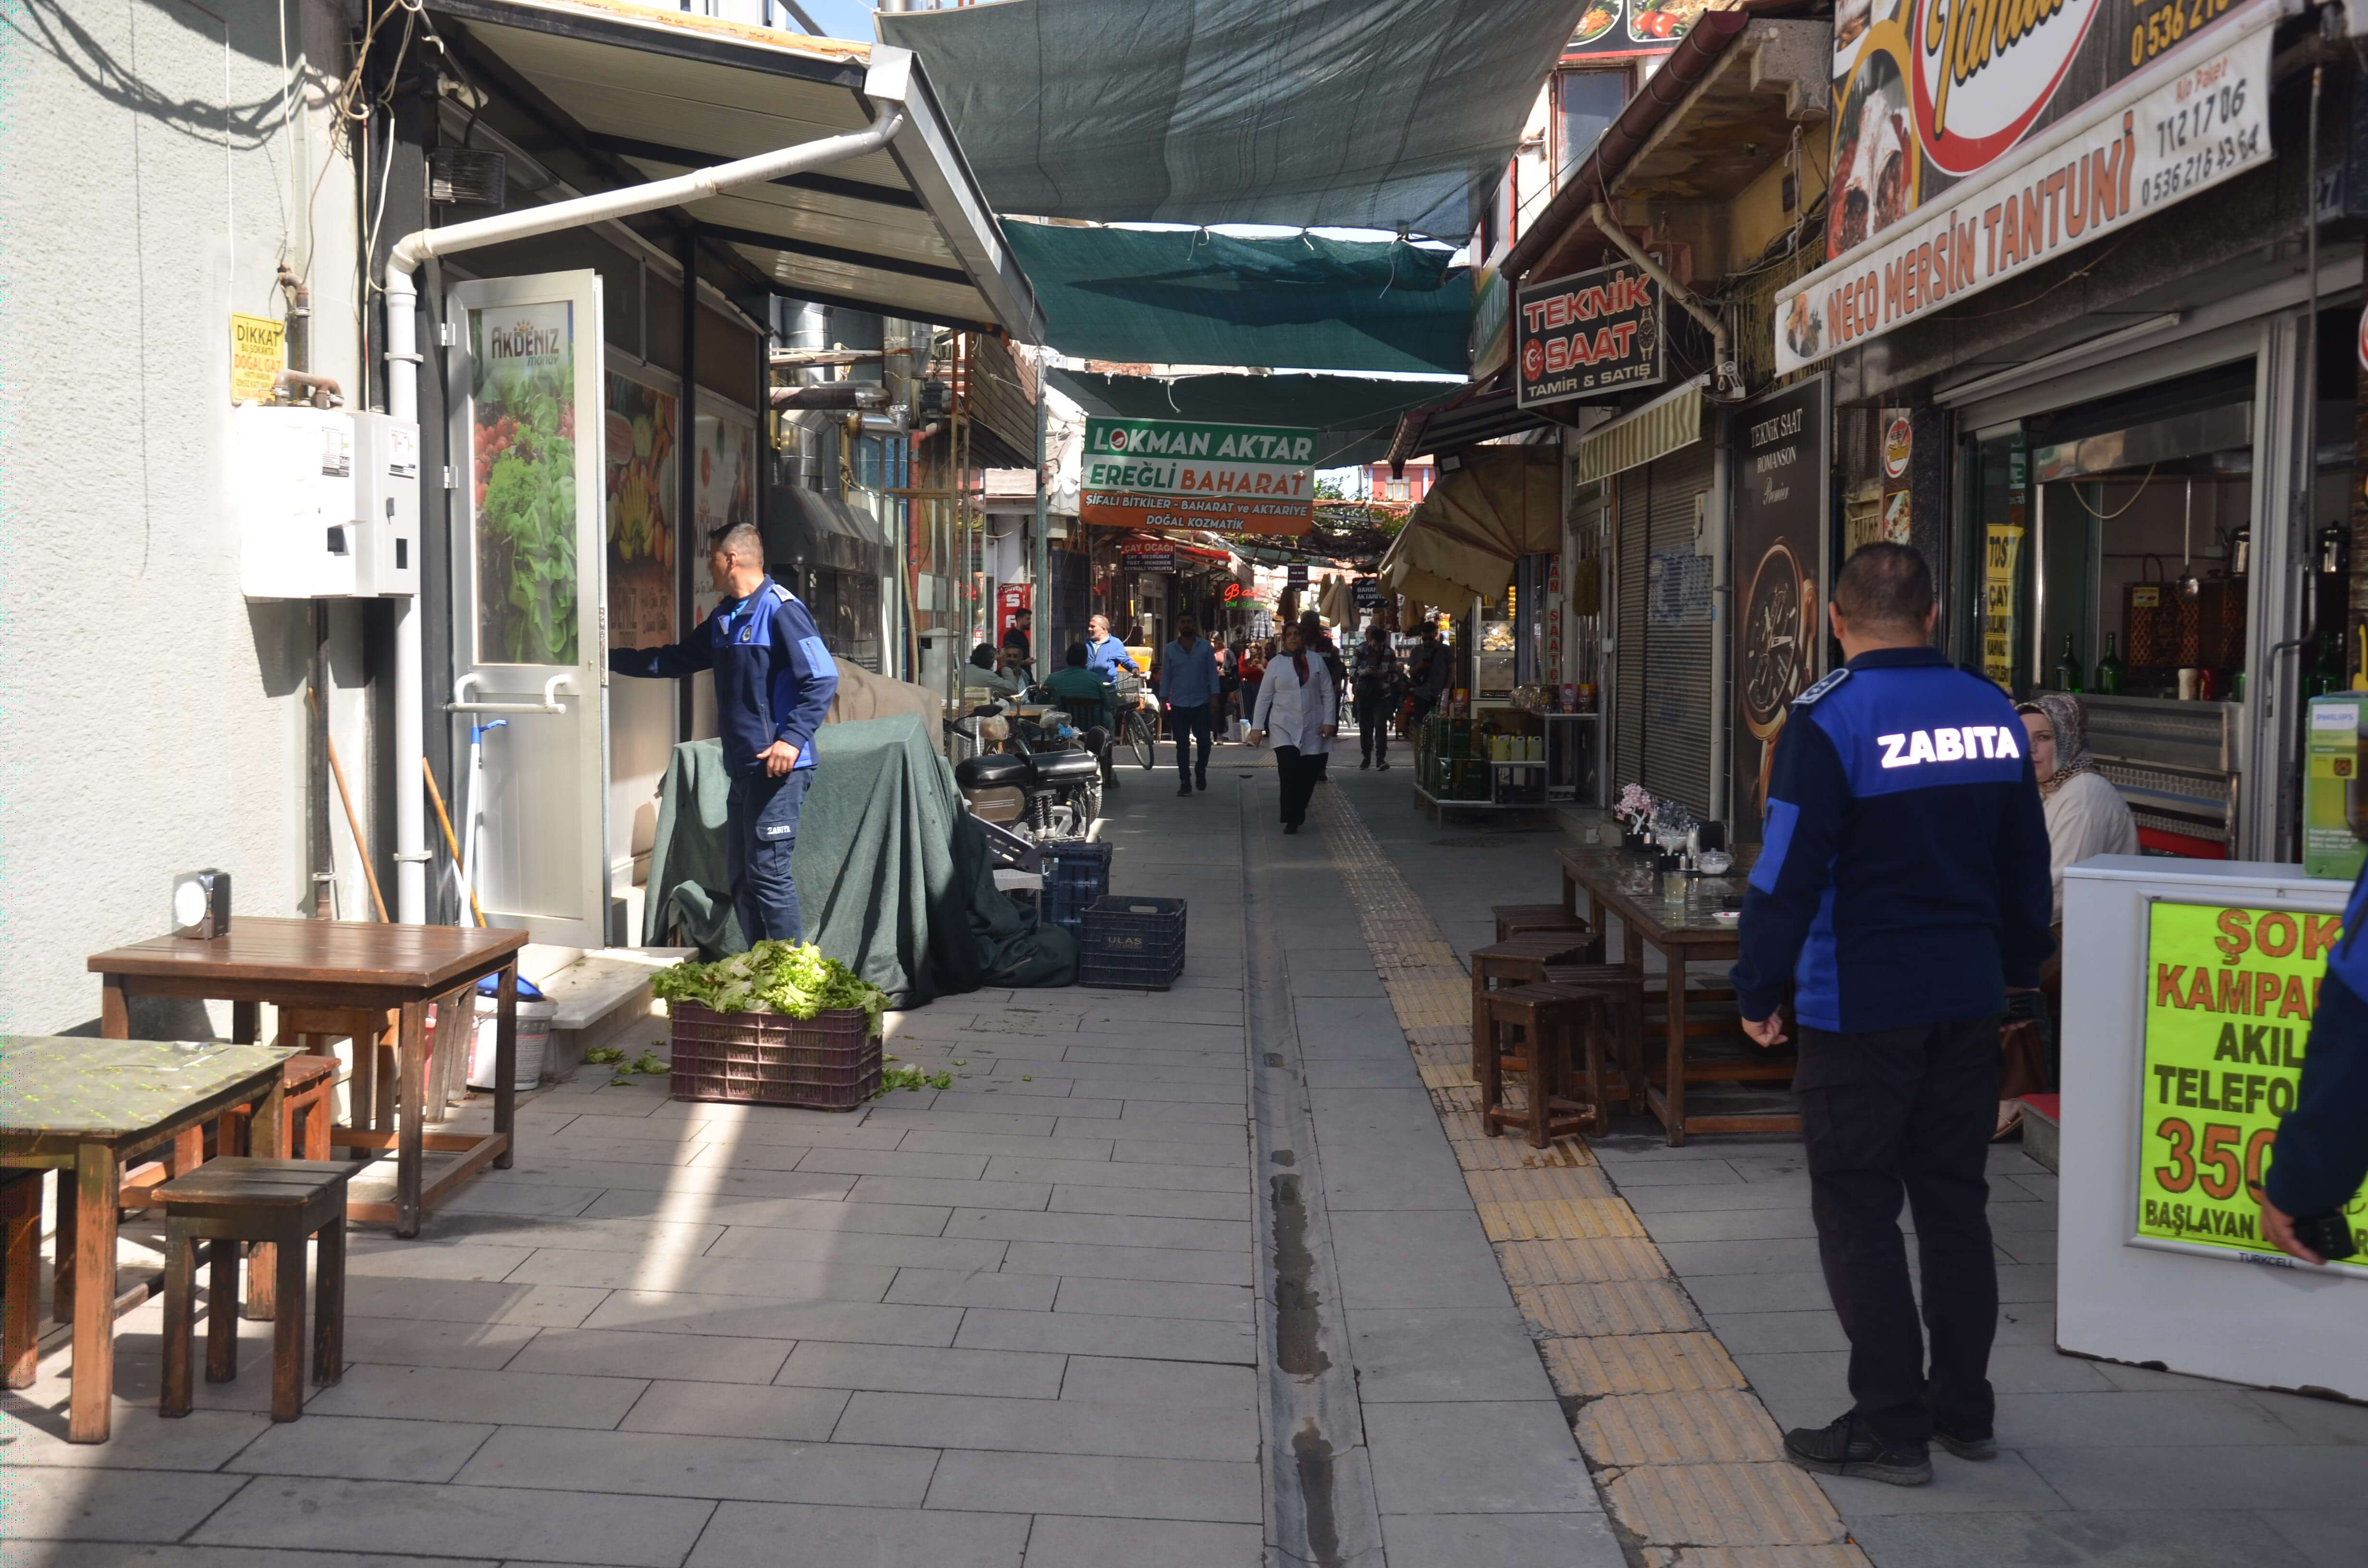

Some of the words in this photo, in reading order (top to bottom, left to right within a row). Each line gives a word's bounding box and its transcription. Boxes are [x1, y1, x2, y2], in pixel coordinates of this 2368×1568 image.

[2147, 0, 2185, 57] 536
[2157, 109, 2187, 158] 712
[2194, 93, 2216, 138] 17
[2220, 78, 2246, 124] 06
[2142, 177, 2150, 207] 0
[2153, 162, 2181, 202] 536
[2184, 147, 2212, 188] 216
[2217, 136, 2235, 170] 43
[1827, 270, 1879, 349] NECO
[1884, 209, 1977, 324] MERSİN
[1983, 109, 2136, 278] TANTUNİ
[1523, 270, 1652, 333] TEKNİK
[237, 322, 278, 347] DİKKAT
[1545, 320, 1637, 374] SAAT
[264, 358, 282, 374] GAZ
[1527, 376, 1578, 398] TAMİR
[1583, 375, 1595, 387] &
[1601, 363, 1651, 384] SATIŞ
[1780, 407, 1803, 437] SAAT
[1093, 427, 1210, 455] LOKMAN
[1216, 434, 1313, 461] AKTAR
[1757, 445, 1797, 473] ROMANSON
[1090, 461, 1177, 489] EREĞLİ
[1180, 468, 1307, 496] BAHARAT
[1085, 493, 1121, 507] ŞİFALI
[1122, 496, 1171, 510] BİTKİLER
[1180, 502, 1234, 513] BAHARAT
[1237, 504, 1249, 514] ve
[1251, 502, 1308, 516] AKTARİYE
[1146, 514, 1184, 527] DOĞAL
[1187, 516, 1245, 530] KOZMATİK
[1124, 543, 1142, 552] ÇAY
[1145, 543, 1173, 552] OCAĞI
[1988, 536, 2017, 568] TOST
[1988, 585, 2010, 612] ÇAY
[1876, 726, 2020, 769] ZABITA
[767, 825, 791, 834] ZABITA
[2214, 909, 2343, 966] ŞOK
[2157, 963, 2321, 1021] KAMPA
[2214, 1022, 2310, 1068] AKIL
[2154, 1064, 2301, 1118] TELEFO
[2145, 1199, 2255, 1240] BAŞLAYAN
[2238, 1252, 2296, 1269] TURKCELL
